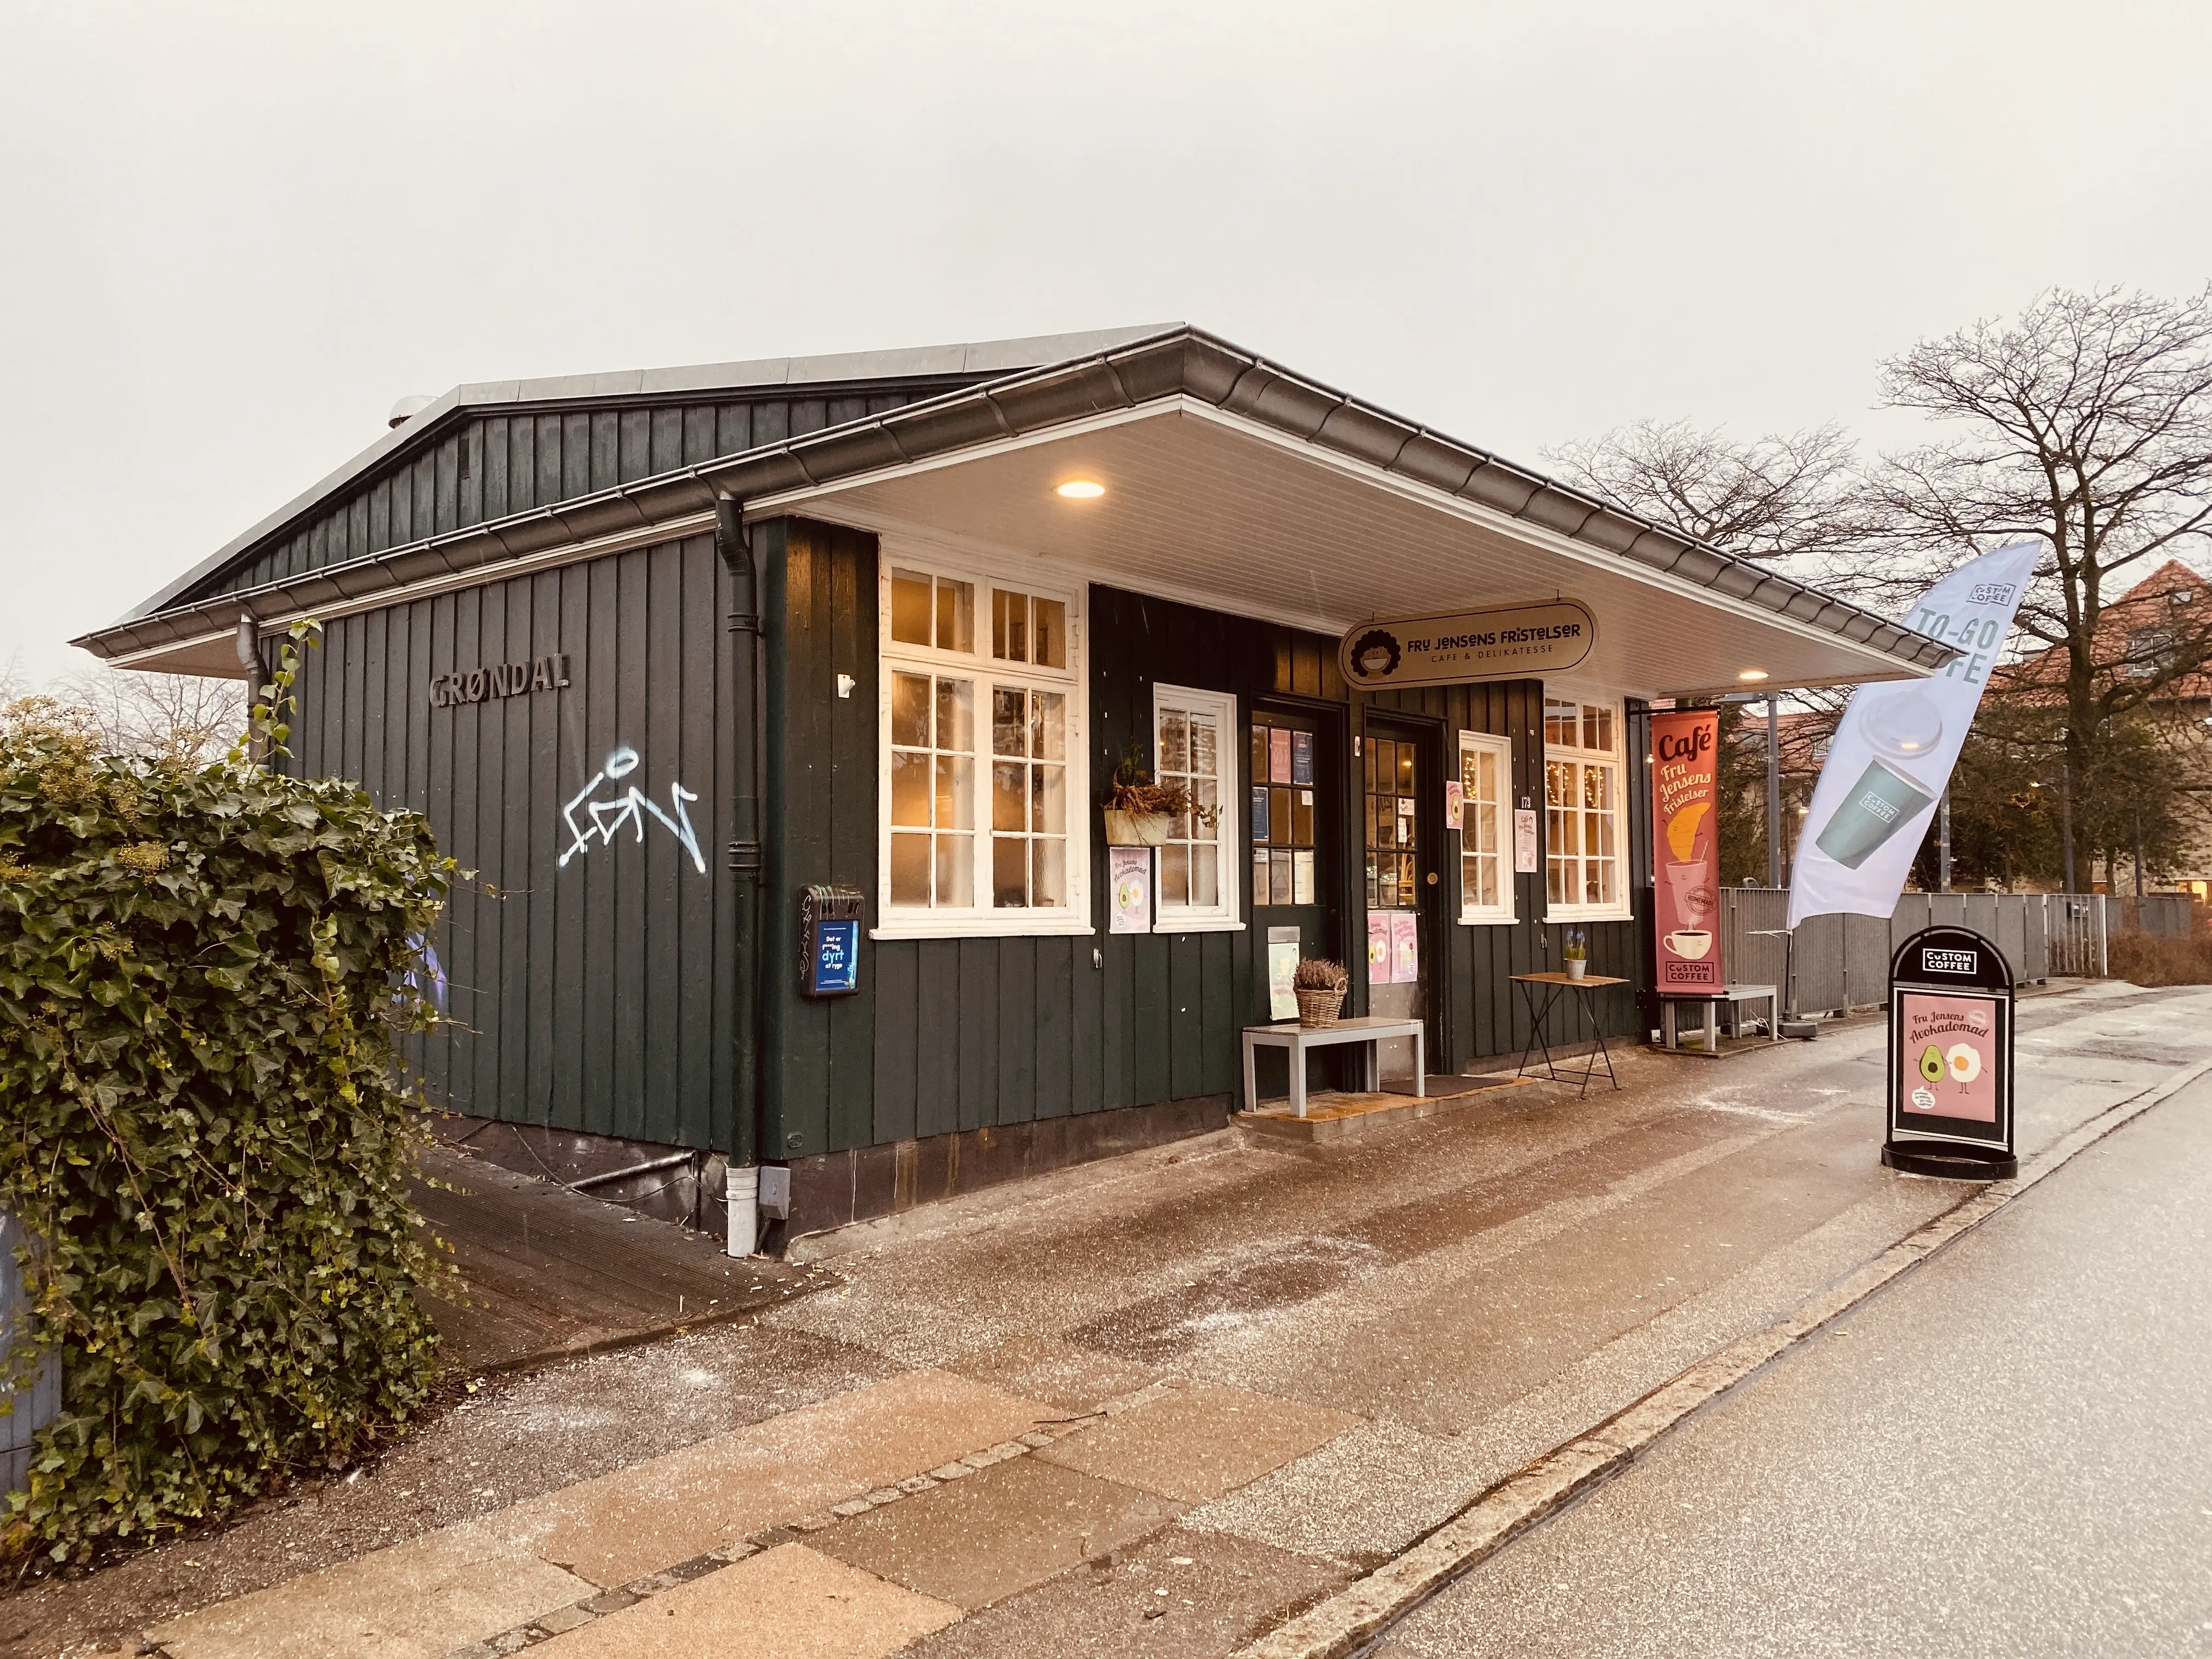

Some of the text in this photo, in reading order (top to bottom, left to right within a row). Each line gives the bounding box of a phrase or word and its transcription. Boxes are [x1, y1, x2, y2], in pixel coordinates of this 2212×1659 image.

[1916, 608, 1999, 650] TO-GO
[1431, 653, 1457, 663] CAFE
[1478, 645, 1553, 658] DELIKATESSE
[429, 653, 569, 707] GRØNDAL
[1658, 724, 1711, 761] Café
[1660, 763, 1687, 781] Fru
[1660, 773, 1711, 803] Jensens
[1521, 796, 1531, 809] 173
[1663, 789, 1709, 815] Fristelser
[1864, 800, 1891, 819] COFFEE
[1688, 895, 1714, 907] HOMEMADE
[822, 949, 845, 964] dyrt
[1928, 960, 1970, 970] COFFEE
[1912, 1015, 1927, 1024] Fru
[1930, 1011, 1964, 1023] Jensens
[1910, 1022, 1989, 1044] Avokadomad
